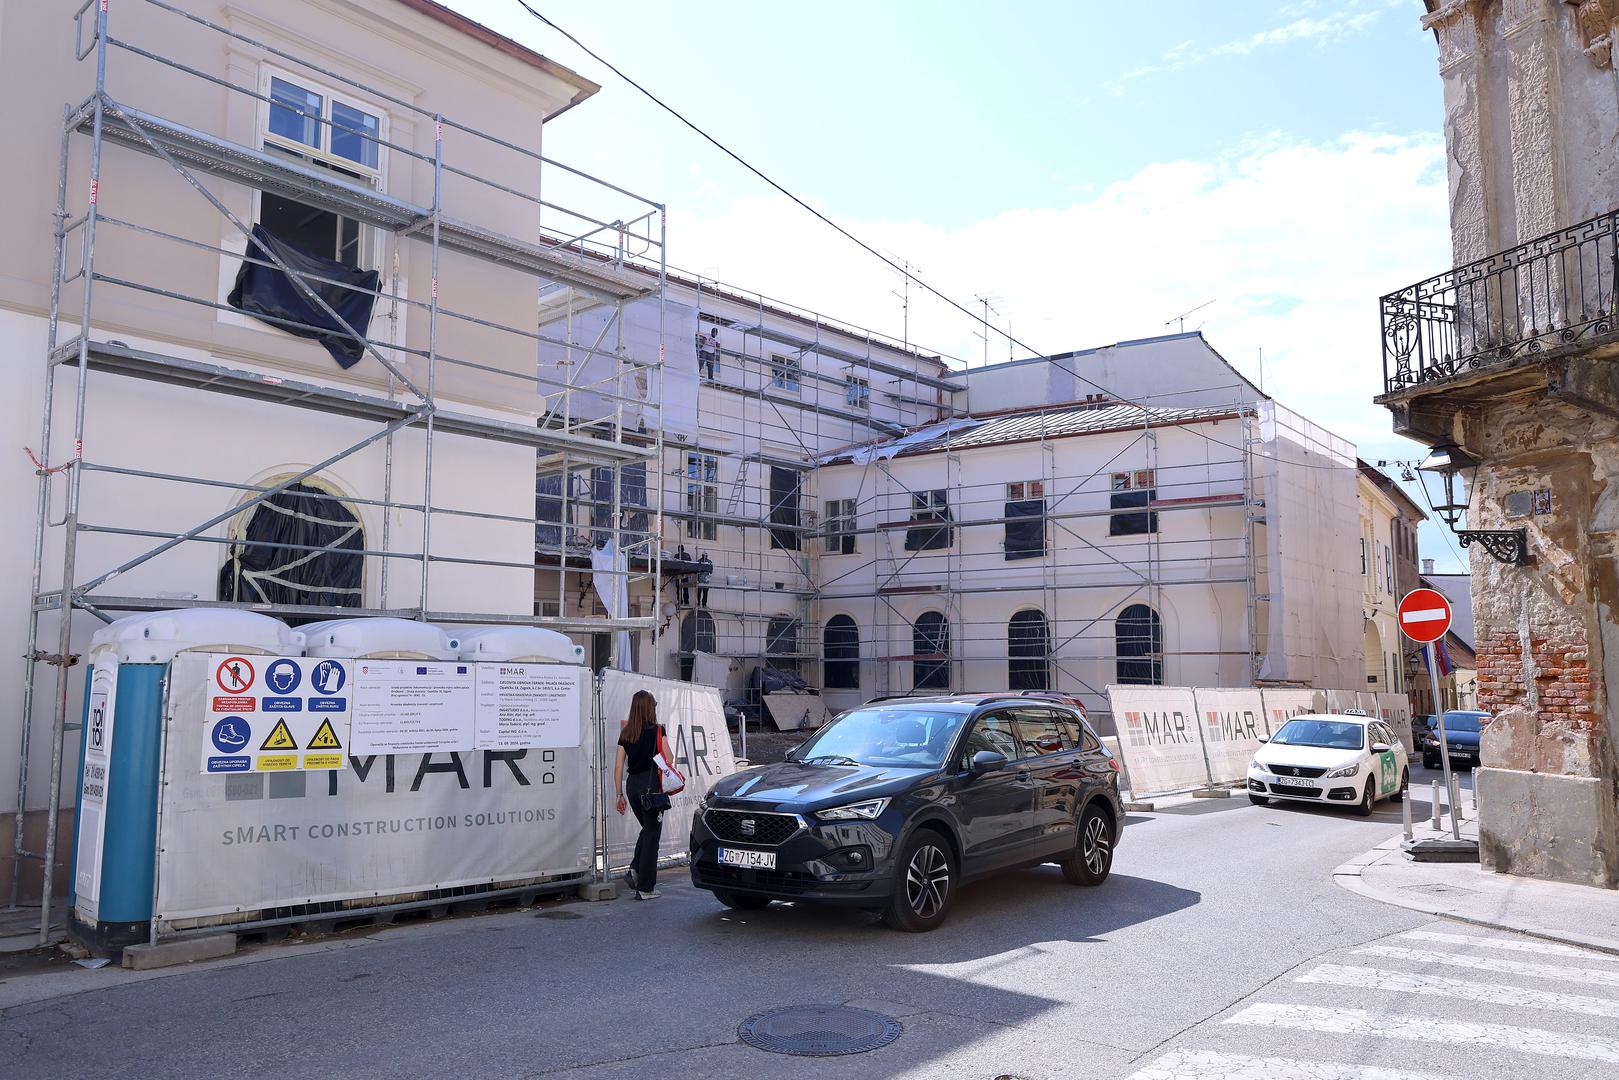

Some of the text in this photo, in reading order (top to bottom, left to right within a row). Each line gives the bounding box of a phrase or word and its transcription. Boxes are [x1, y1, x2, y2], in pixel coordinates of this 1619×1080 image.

[1143, 711, 1188, 745] MAR
[1220, 711, 1258, 741] MAR
[308, 815, 457, 839] CONSTRUCTION
[464, 808, 556, 827] SOLUTIONS
